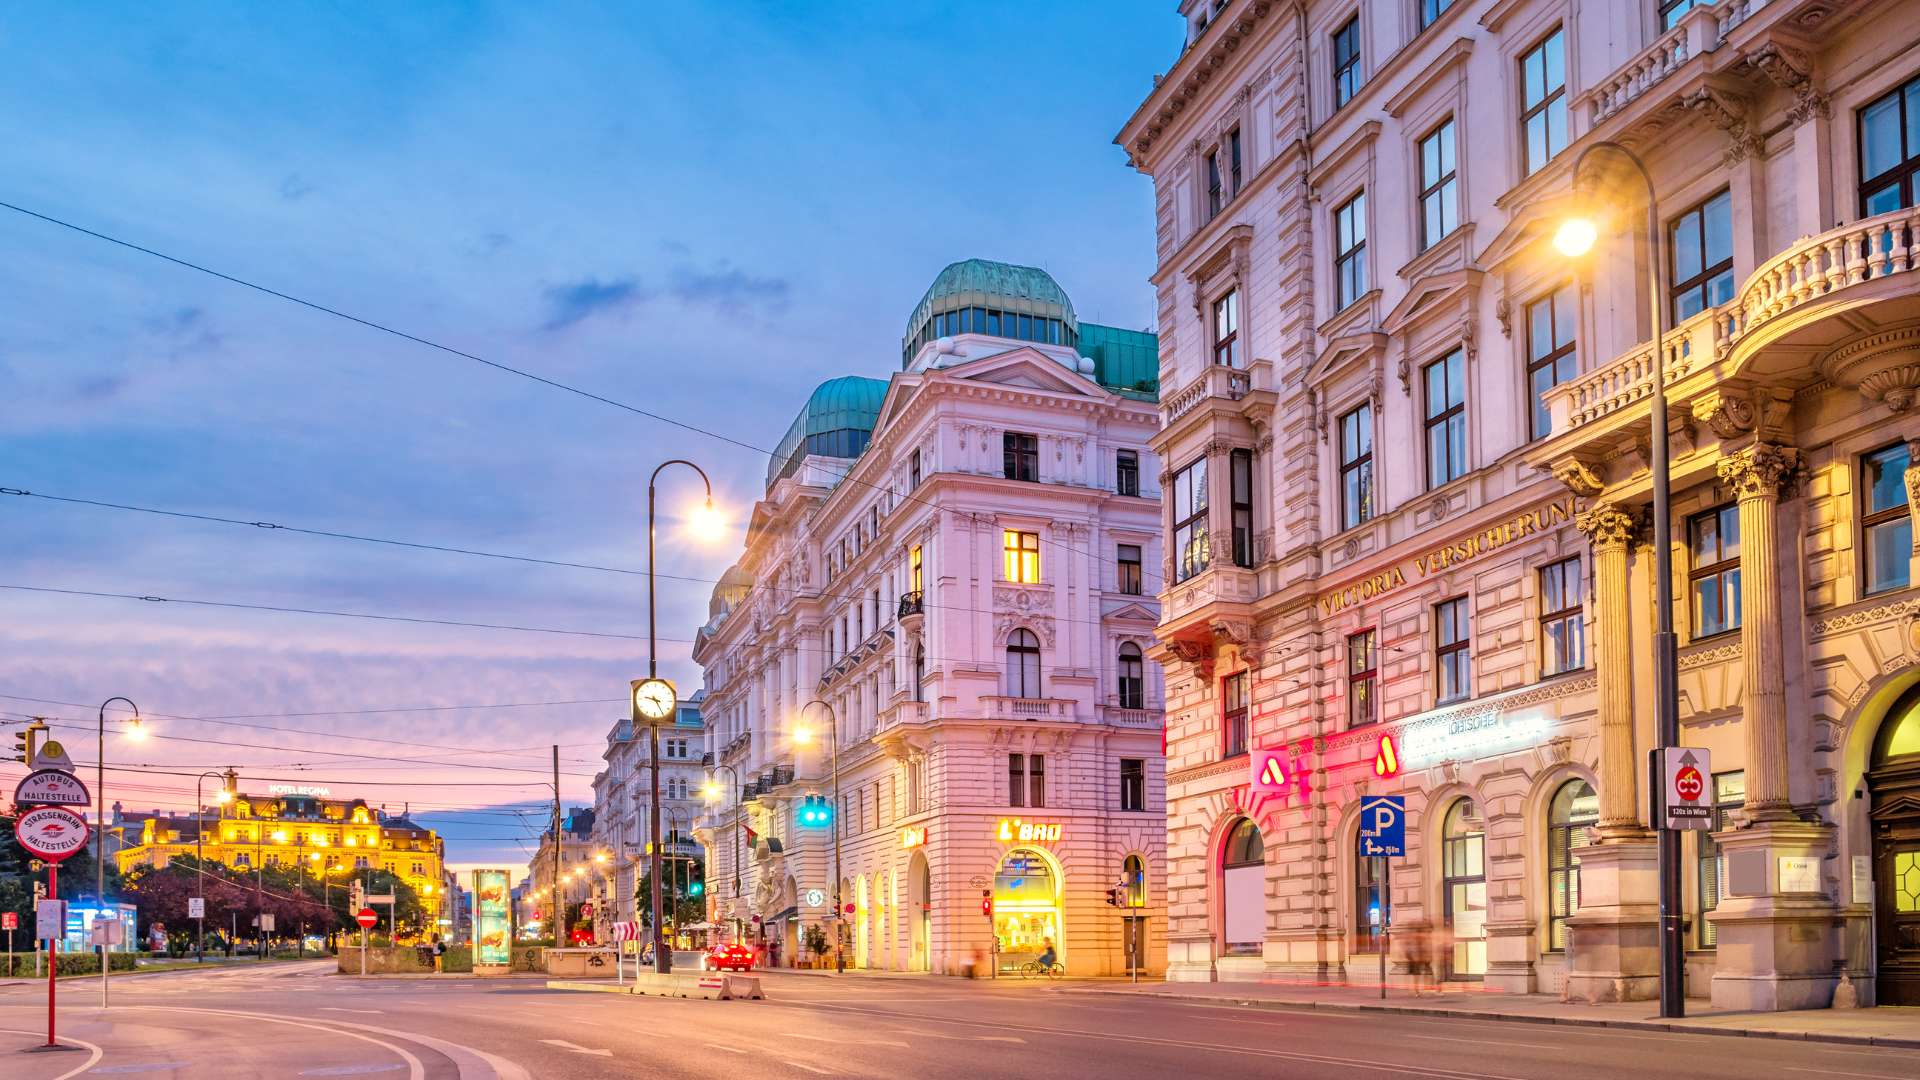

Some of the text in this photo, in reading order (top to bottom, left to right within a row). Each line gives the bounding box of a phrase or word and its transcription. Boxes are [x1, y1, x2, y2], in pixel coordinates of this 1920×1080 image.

[1320, 566, 1407, 615] VICTORIA
[33, 774, 74, 788] AUTOBUS
[24, 792, 81, 802] HALTESTELLE
[269, 785, 297, 794] HOTEL
[24, 811, 82, 830] STRASSENBAHN
[1376, 807, 1395, 837] P
[27, 835, 79, 850] HALTESTELLE
